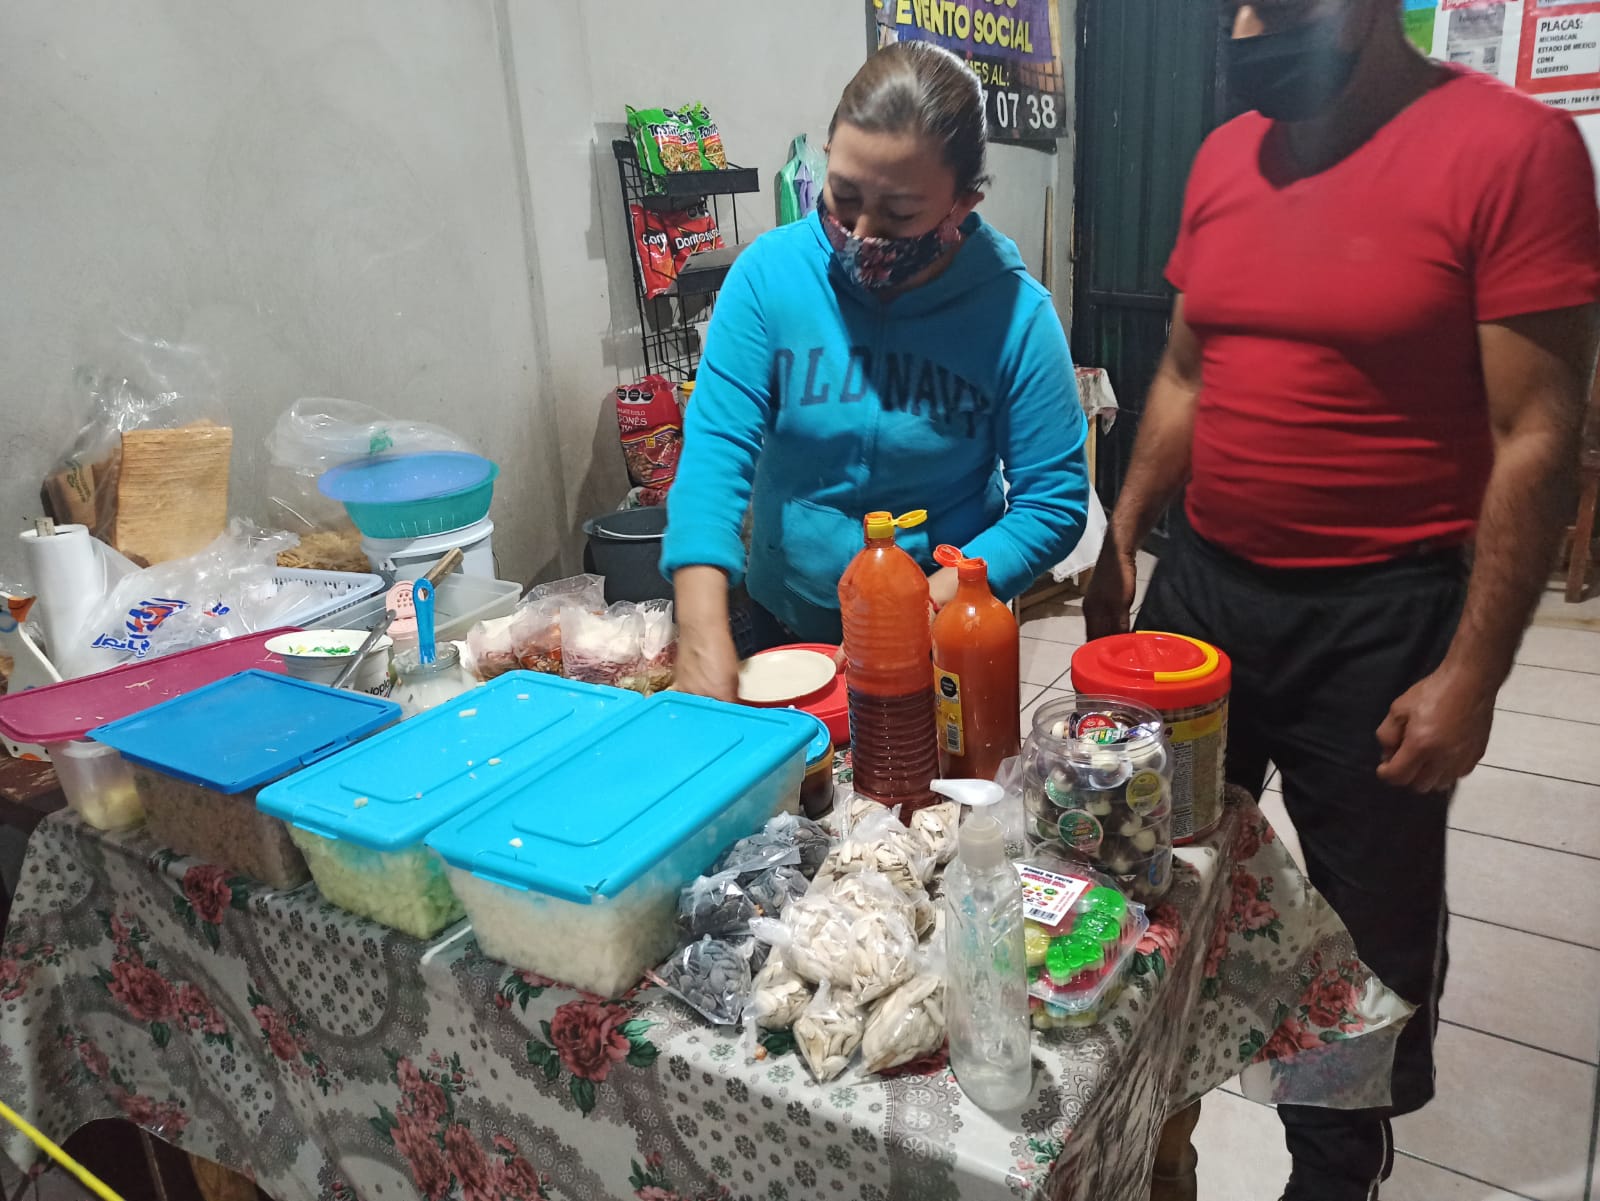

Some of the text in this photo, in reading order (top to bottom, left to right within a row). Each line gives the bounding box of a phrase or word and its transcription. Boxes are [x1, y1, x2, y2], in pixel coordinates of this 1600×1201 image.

[896, 0, 1033, 53] EVENTO SOCIAL
[1541, 18, 1583, 32] PLACAS:
[1539, 33, 1577, 43] MICHOACAN
[1538, 42, 1597, 54] ESTADO DE MEXICO
[991, 64, 1010, 87] AL:
[1536, 65, 1569, 75] GUERRERO
[997, 91, 1019, 128] 07
[1026, 94, 1057, 130] 38
